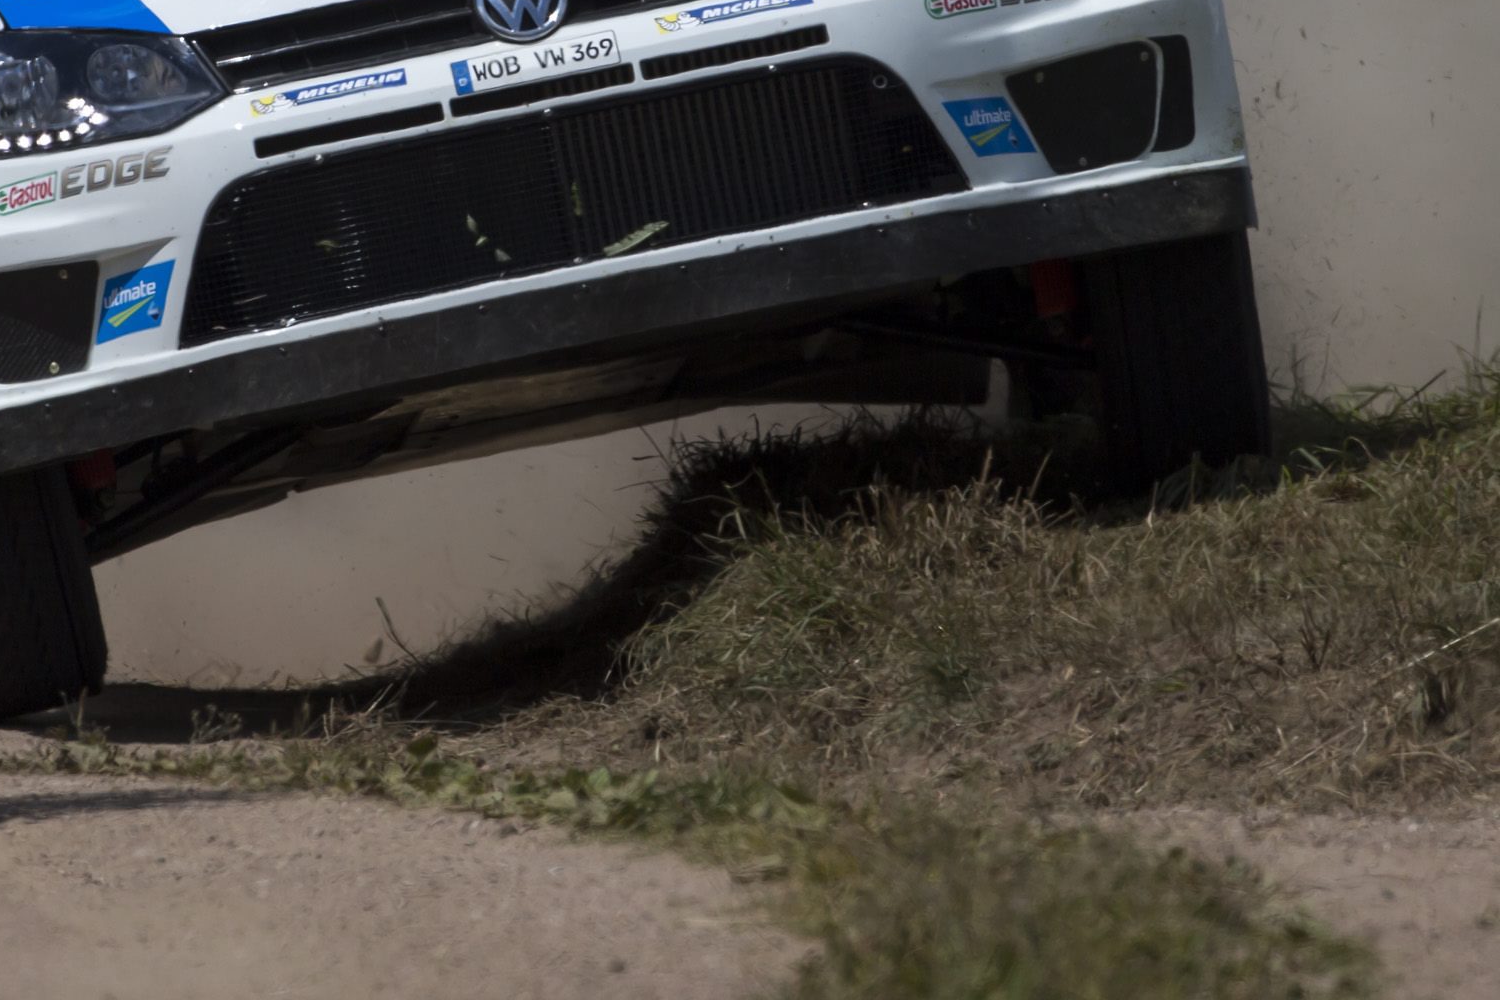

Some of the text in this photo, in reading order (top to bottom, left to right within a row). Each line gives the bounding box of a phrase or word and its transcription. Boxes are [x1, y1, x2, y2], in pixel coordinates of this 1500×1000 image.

[473, 38, 613, 81] WOB VW 369
[297, 71, 404, 100] MICHELIN
[964, 107, 1012, 127] ultimate
[9, 146, 173, 209] Castrol EDGE
